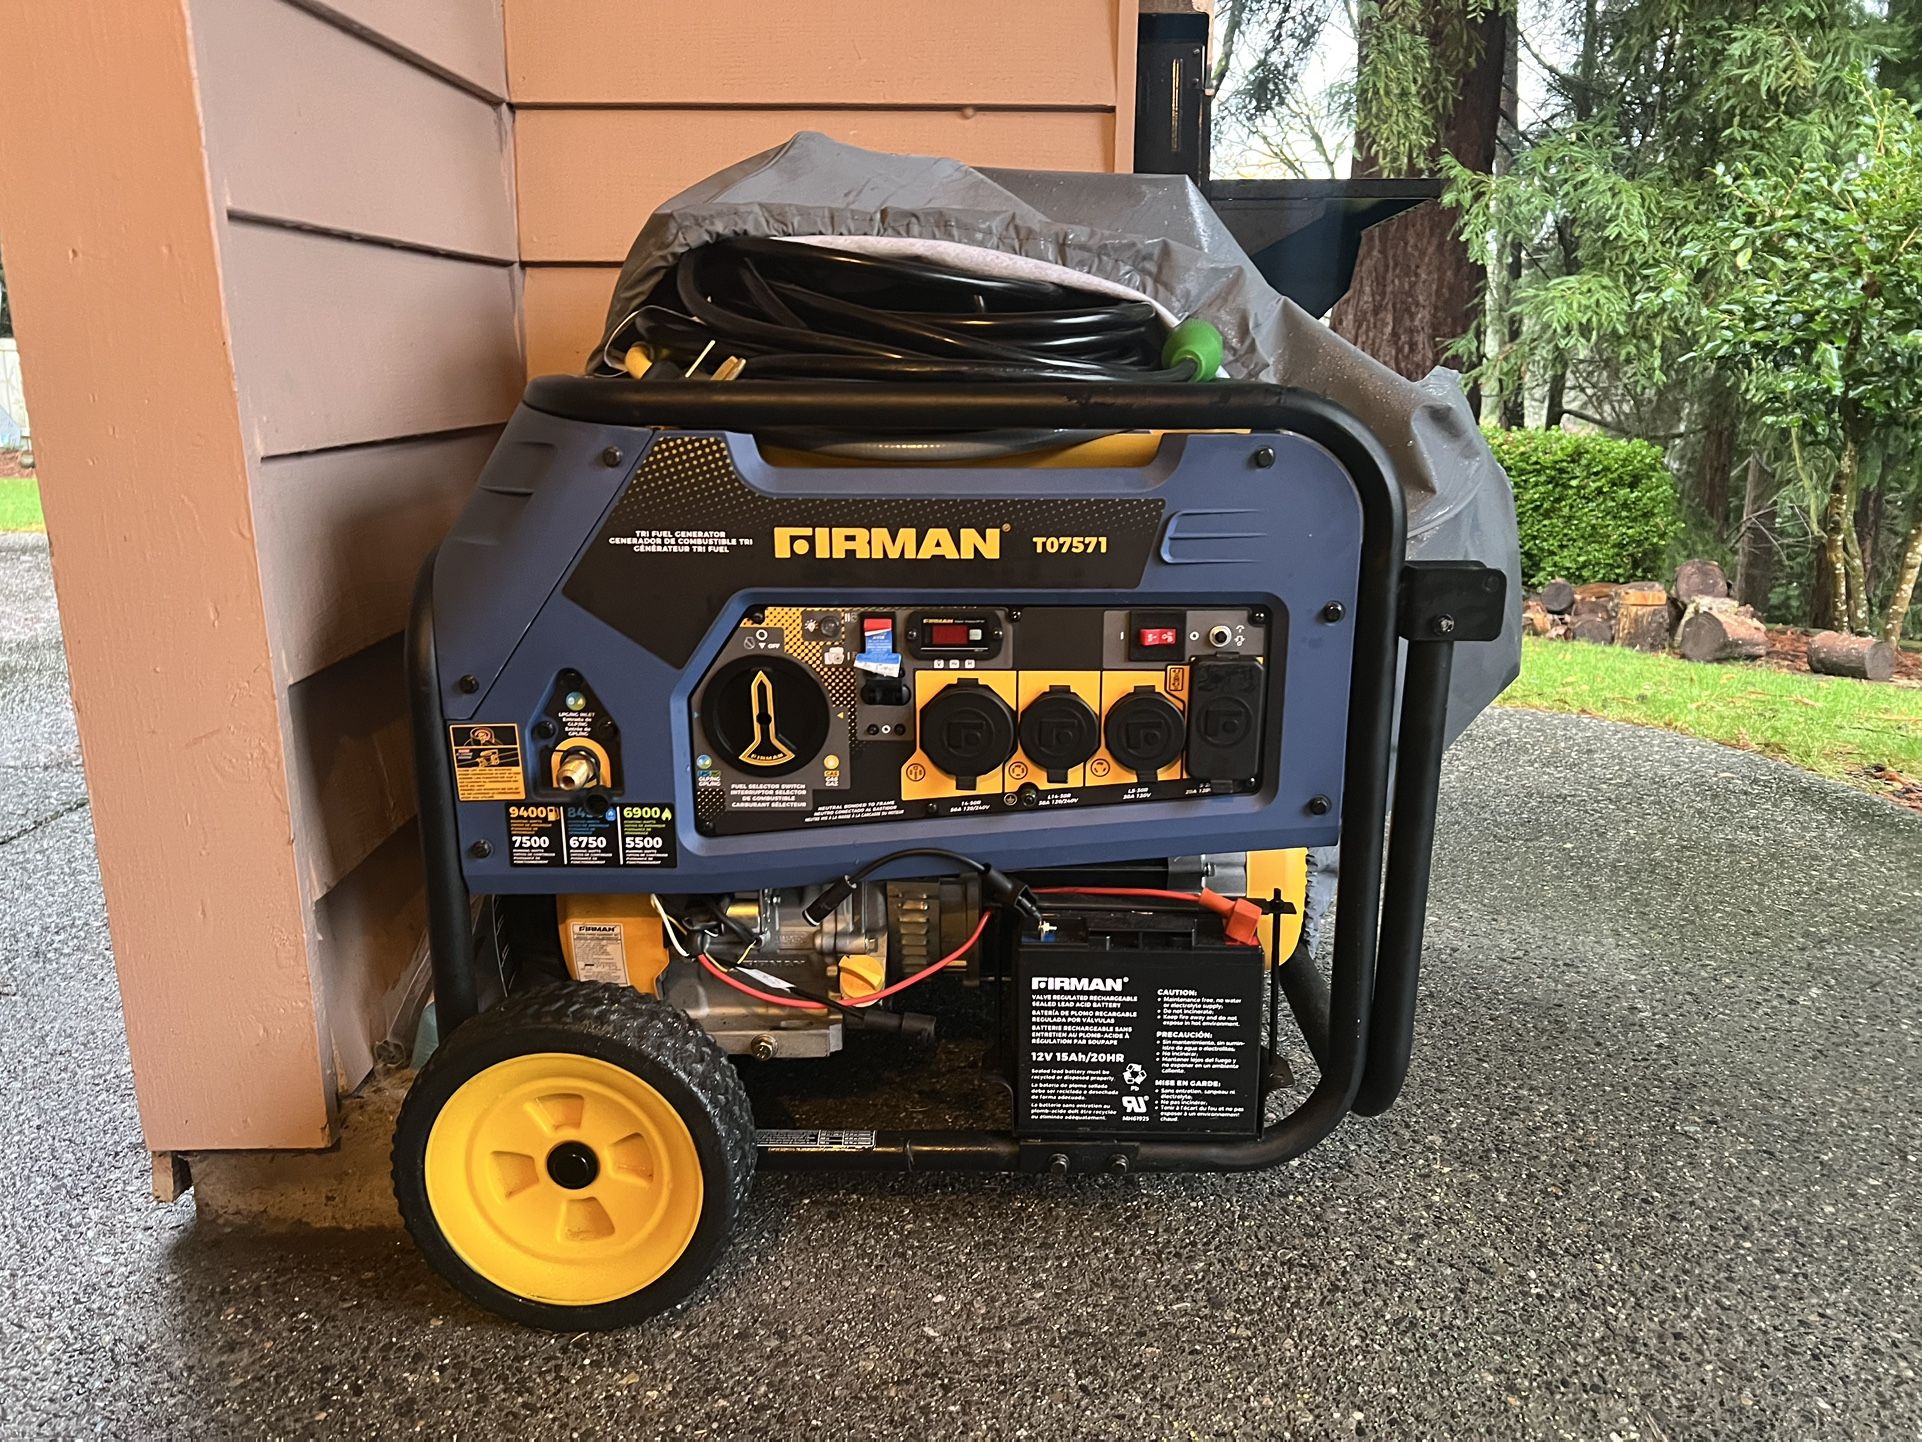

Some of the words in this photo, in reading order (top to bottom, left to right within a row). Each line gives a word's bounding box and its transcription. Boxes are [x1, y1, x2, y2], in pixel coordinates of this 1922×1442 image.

[1033, 537, 1108, 553] T07571
[509, 807, 546, 817] 9400
[624, 807, 661, 818] 6900
[512, 837, 550, 848] 7500
[569, 837, 607, 848] 6750
[625, 837, 663, 848] 5500
[1031, 1052, 1053, 1061] 12V
[1056, 1052, 1124, 1063] 15Ah/20HR
